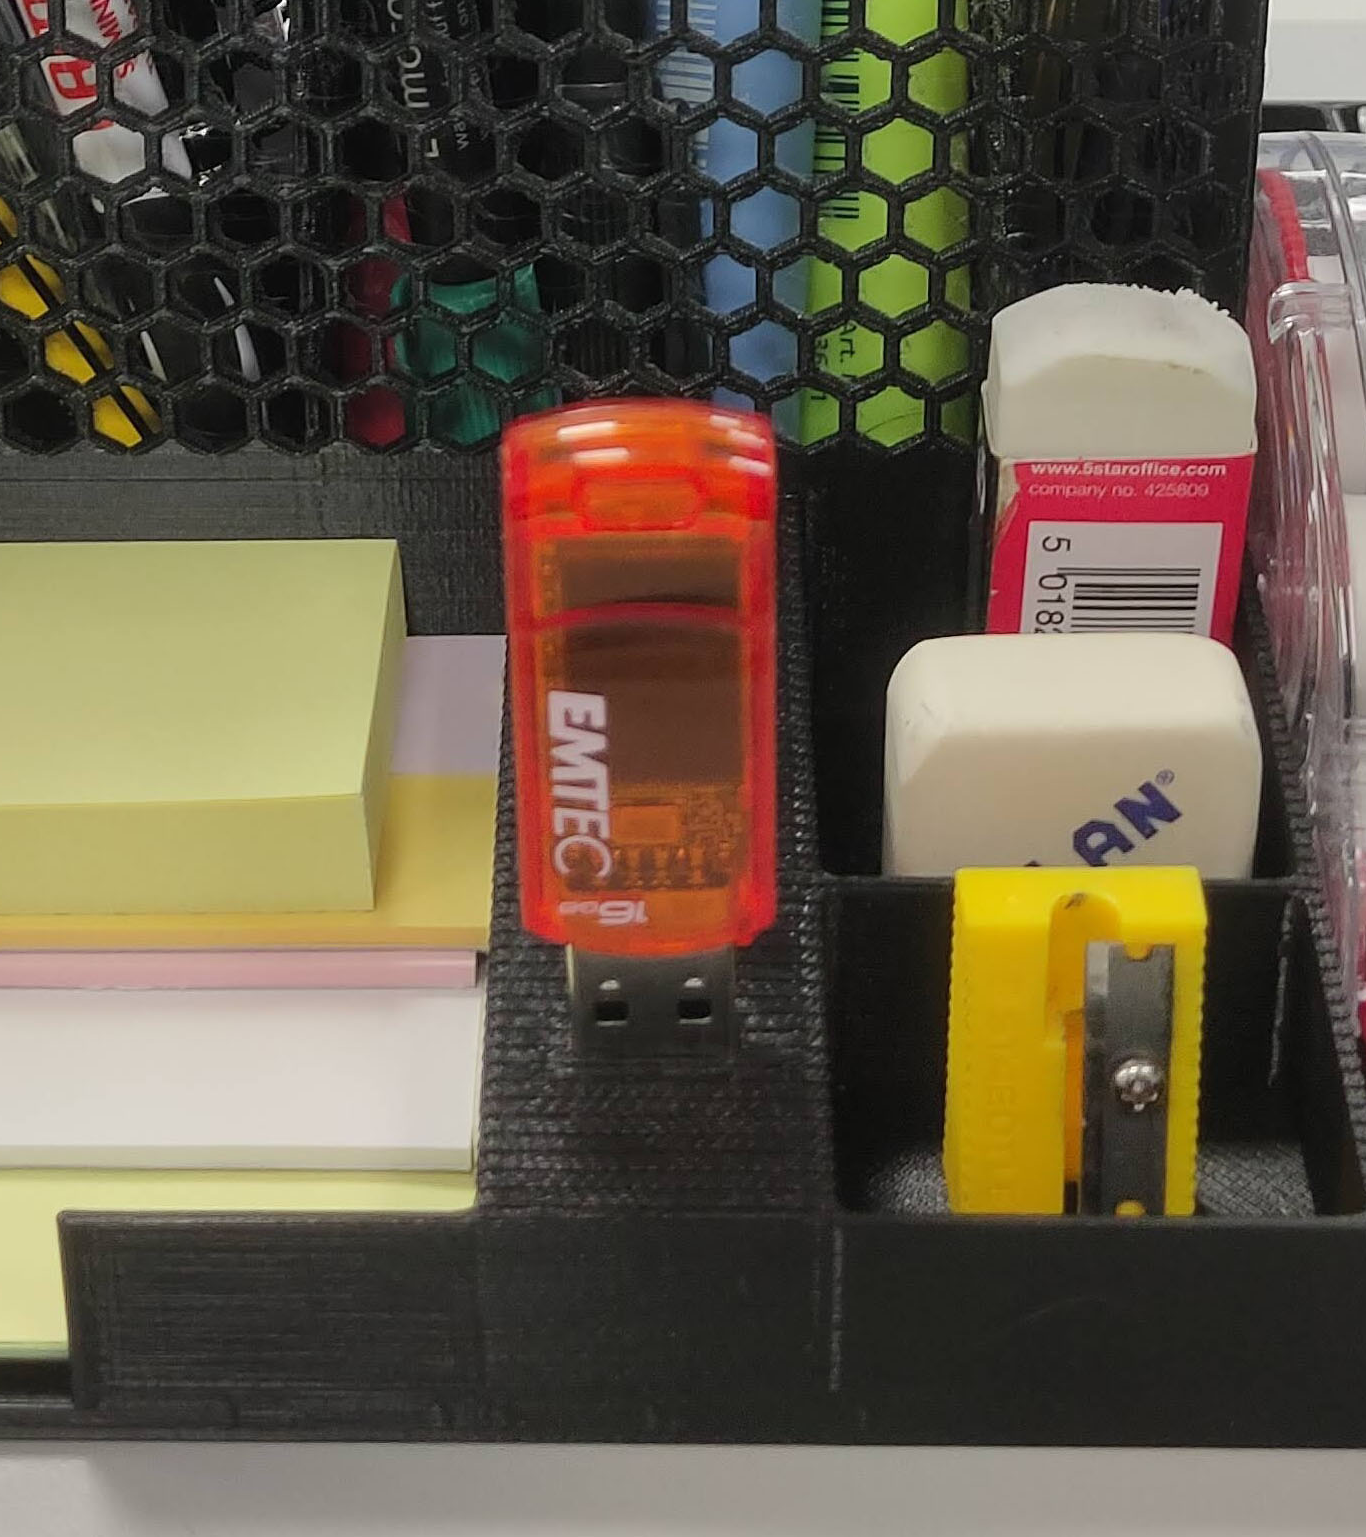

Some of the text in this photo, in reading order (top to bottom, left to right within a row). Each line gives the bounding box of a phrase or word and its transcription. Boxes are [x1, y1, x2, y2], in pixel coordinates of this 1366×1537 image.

[1028, 483, 1108, 499] company
[1111, 483, 1137, 497] no.
[1031, 462, 1227, 477] www.5staroffice.com
[1035, 536, 1071, 634] 5 018
[547, 689, 613, 879] EMTEC
